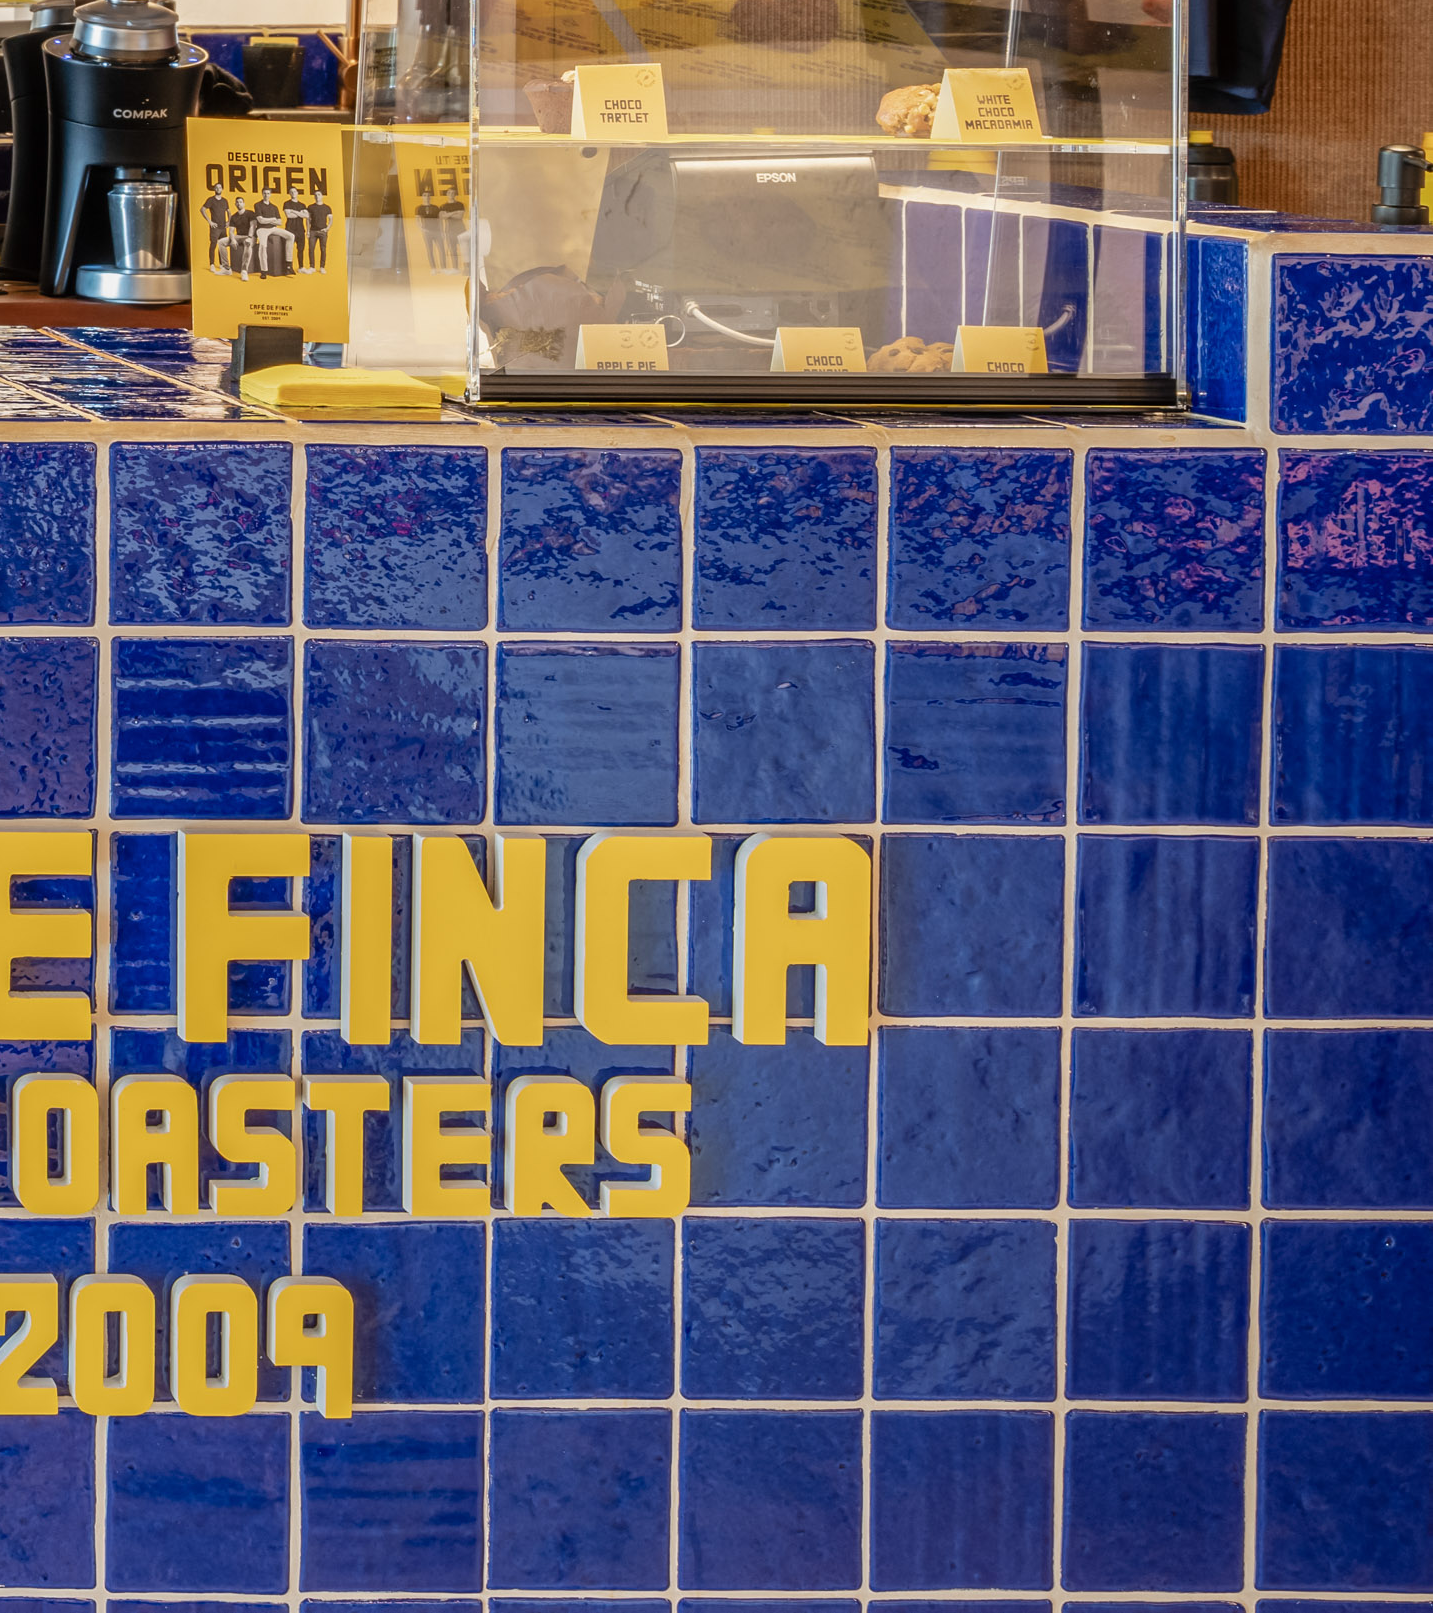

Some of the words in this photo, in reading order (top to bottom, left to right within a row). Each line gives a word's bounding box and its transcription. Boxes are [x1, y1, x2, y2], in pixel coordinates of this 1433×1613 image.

[604, 99, 642, 110] CHOCO
[977, 94, 1011, 105] WHITE
[112, 106, 169, 121] COMPAK
[600, 112, 649, 123] TARTLET
[978, 107, 1015, 117] CHOCO
[965, 119, 1034, 130] MACADAMIA
[227, 151, 285, 164] DESCUBRE
[289, 152, 304, 164] TU
[205, 163, 328, 196] ORIGEN
[756, 172, 797, 183] EPSON
[597, 361, 634, 371] APPLE
[638, 361, 657, 371] PIE
[806, 355, 844, 366] CHOCO
[987, 361, 1025, 373] CHOCO
[177, 829, 873, 1049] FINCA
